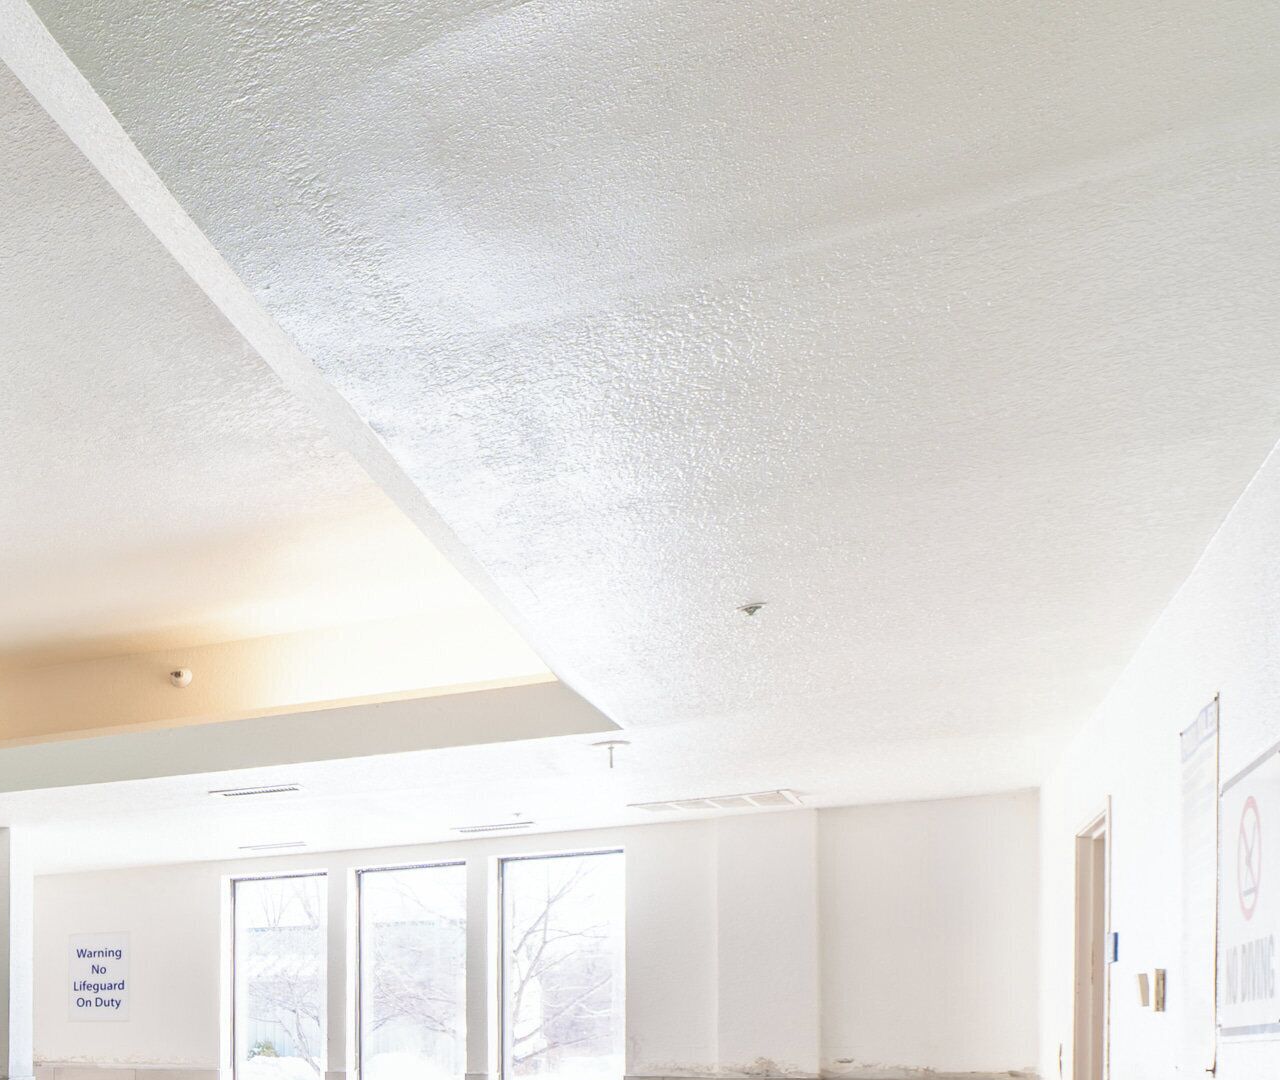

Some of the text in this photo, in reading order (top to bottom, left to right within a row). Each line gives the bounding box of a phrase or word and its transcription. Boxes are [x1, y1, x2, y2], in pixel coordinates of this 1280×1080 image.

[76, 948, 122, 960] Warning
[91, 964, 107, 974] No
[73, 979, 125, 993] Lifeguard
[76, 997, 121, 1009] On Duty
